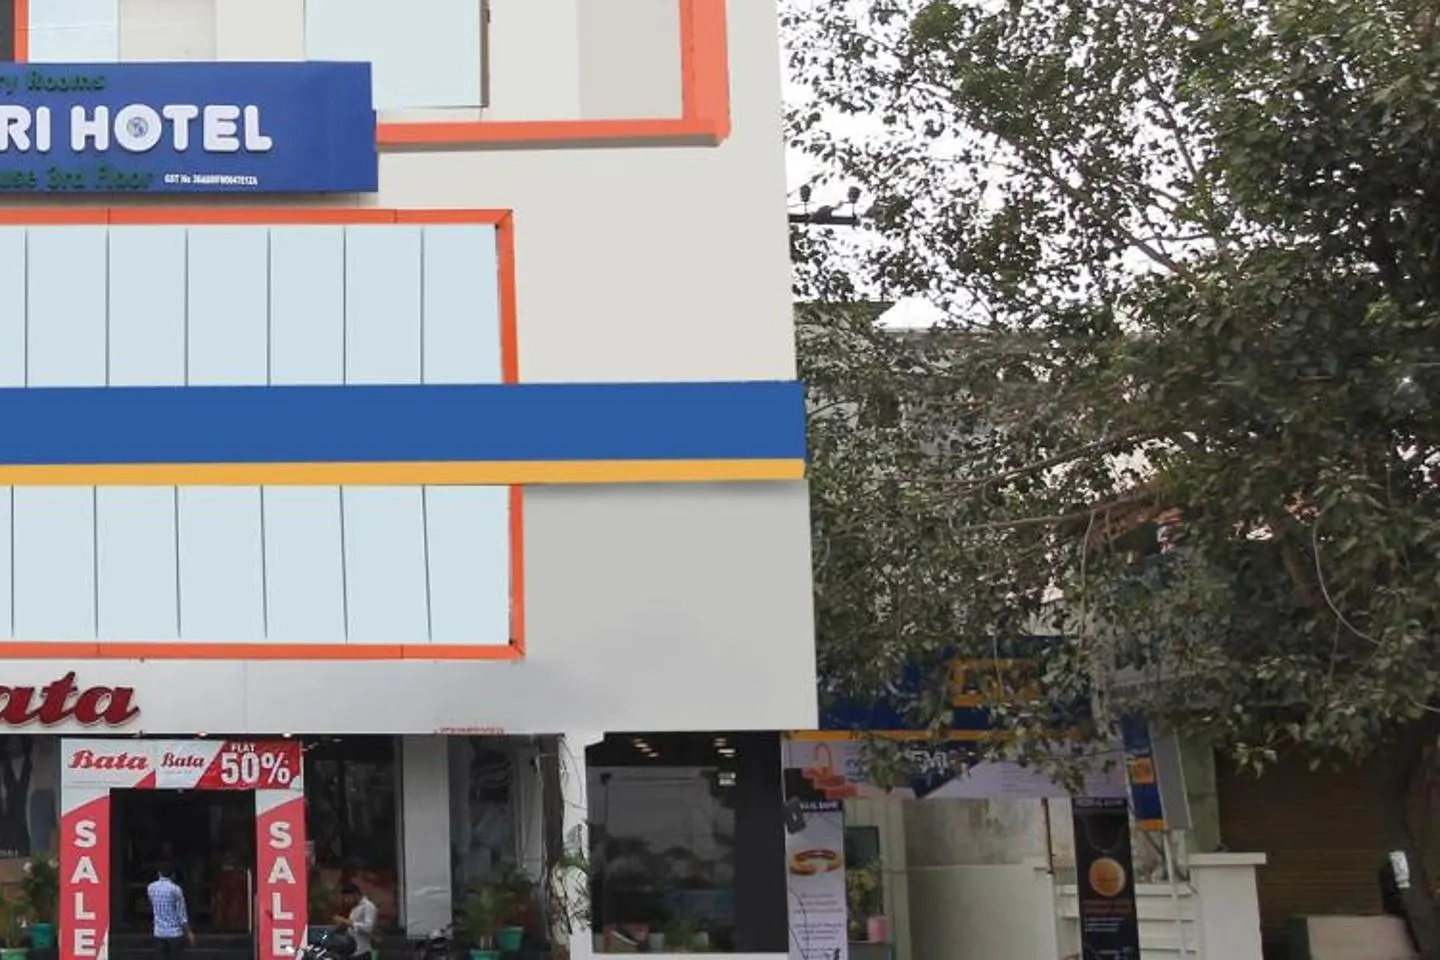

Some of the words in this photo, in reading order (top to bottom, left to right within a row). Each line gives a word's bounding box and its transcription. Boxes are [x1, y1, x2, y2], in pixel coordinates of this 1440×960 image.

[71, 103, 274, 153] HOTEL
[67, 750, 149, 771] Bata
[161, 752, 205, 769] Bata
[220, 752, 291, 785] 50%
[73, 820, 100, 957] SALE
[267, 821, 297, 957] SALE
